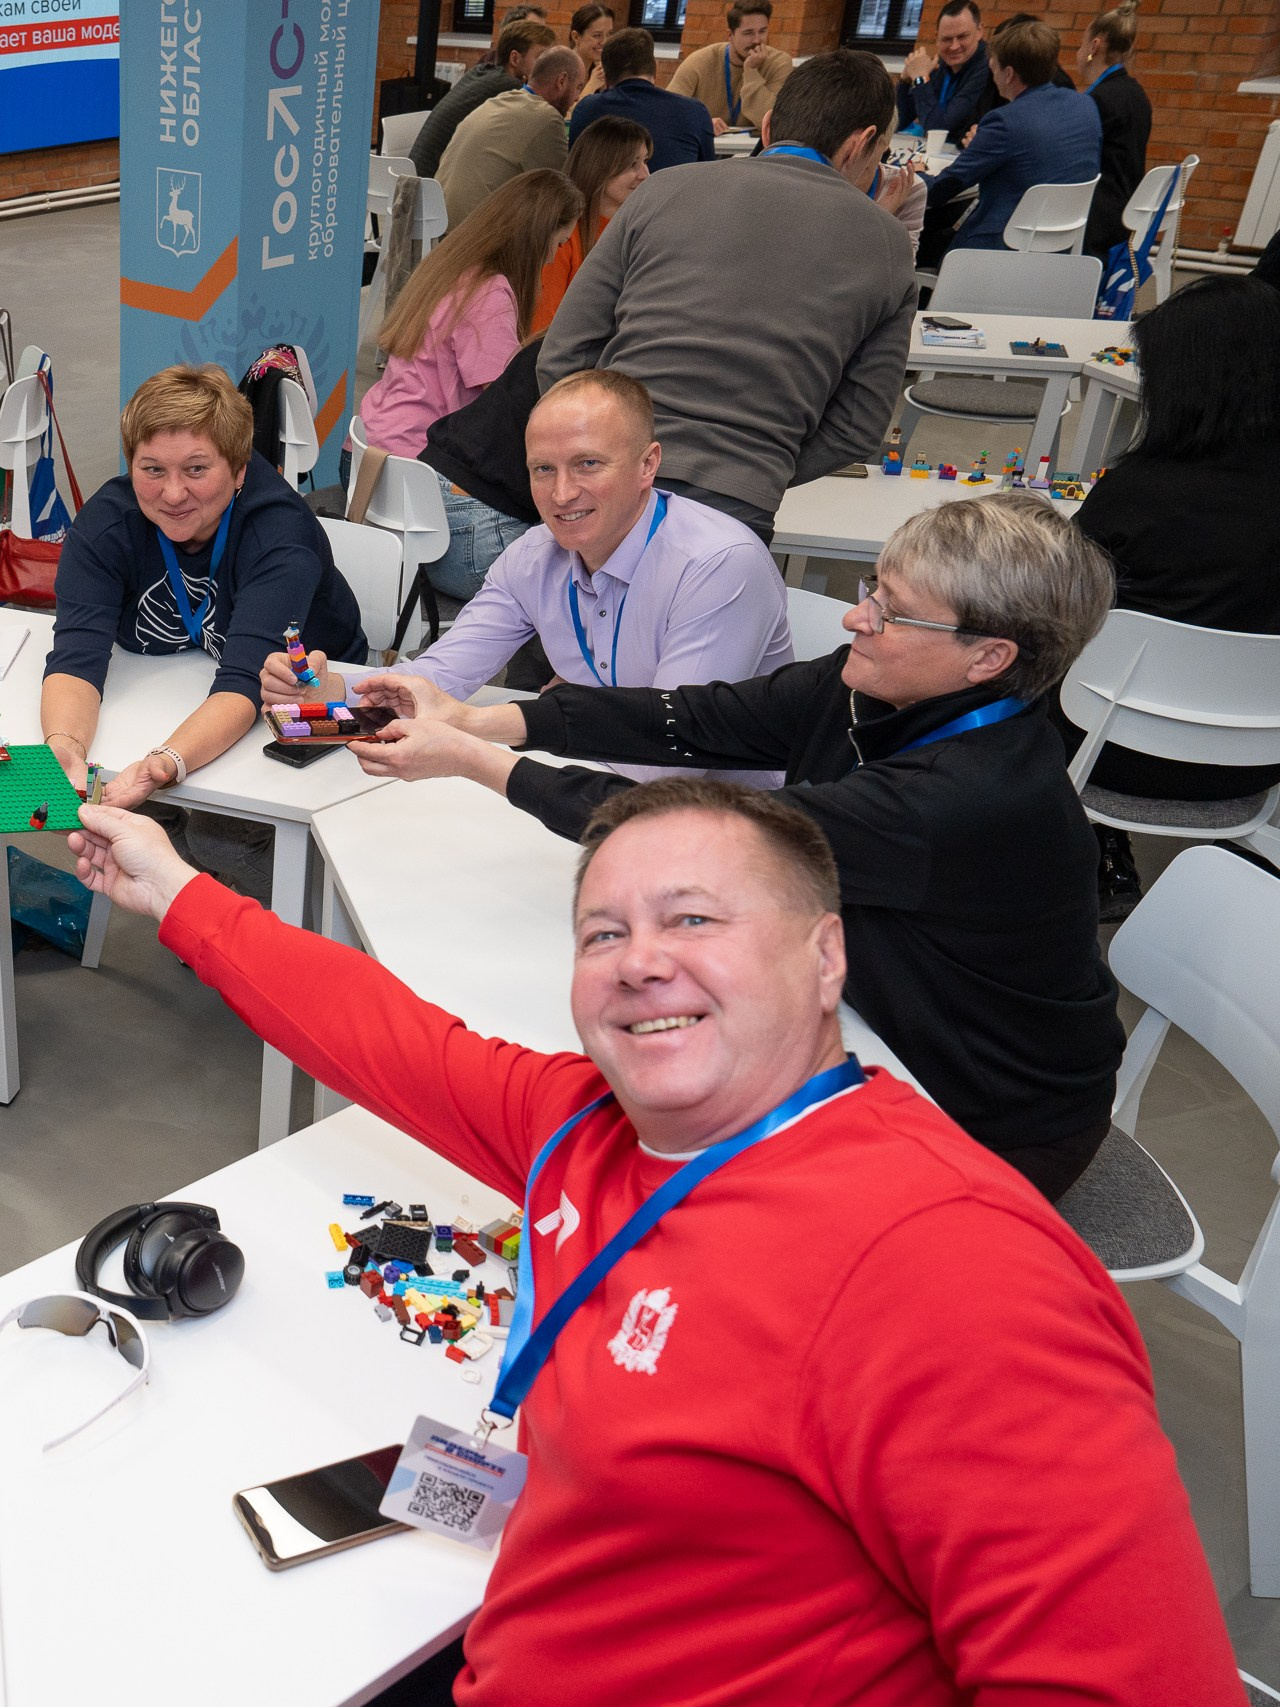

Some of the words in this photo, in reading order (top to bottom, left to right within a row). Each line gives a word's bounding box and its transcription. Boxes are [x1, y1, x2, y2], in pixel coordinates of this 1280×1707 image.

[32, 27, 76, 45] ваша
[160, 0, 178, 143] НИЖЕГ
[308, 50, 329, 261] круглогодичный
[321, 26, 347, 258] образовательный
